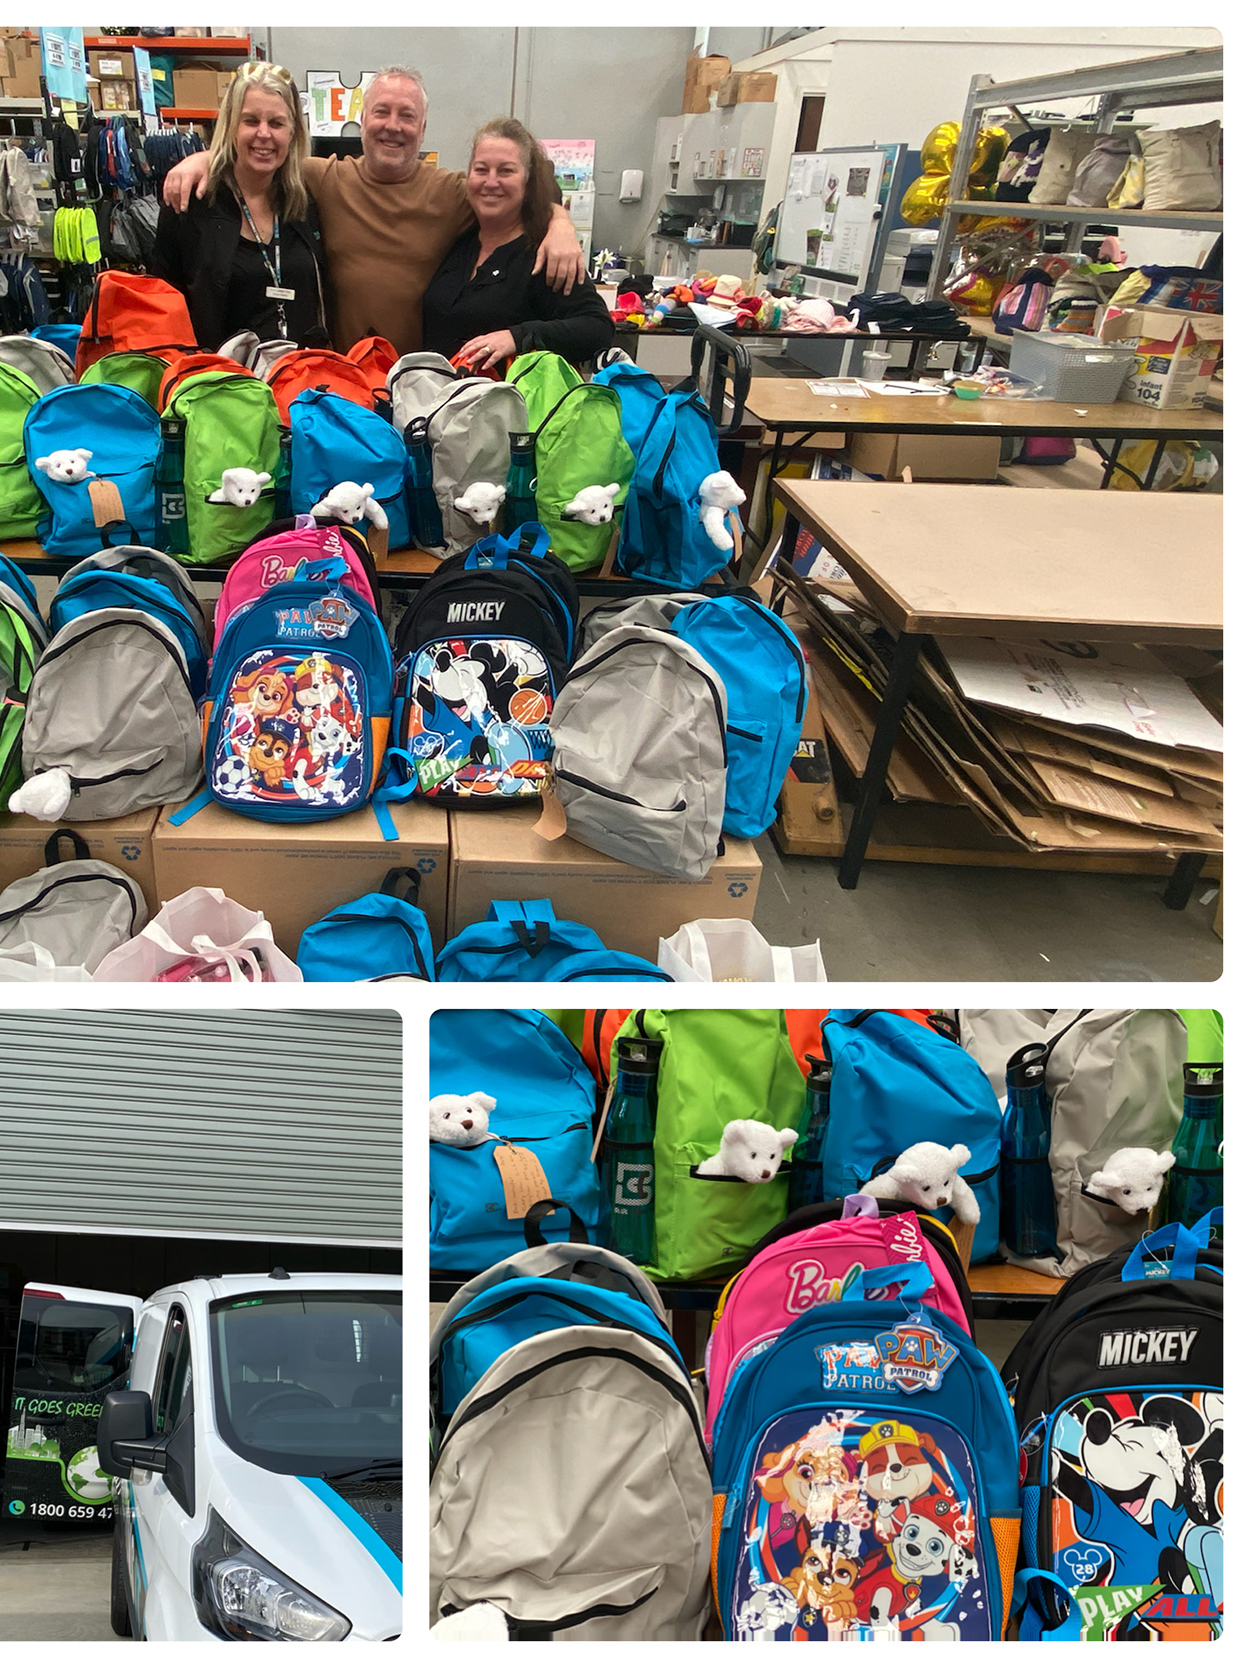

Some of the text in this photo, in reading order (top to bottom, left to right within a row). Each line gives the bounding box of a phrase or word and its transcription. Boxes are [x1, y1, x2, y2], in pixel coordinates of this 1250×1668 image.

[1137, 388, 1160, 402] 104
[261, 555, 323, 589] Bare
[309, 602, 358, 626] PAW
[447, 602, 505, 623] MICKEY
[317, 624, 344, 633] PATROL
[793, 741, 816, 758] AT
[420, 760, 460, 786] PLAY
[1145, 1268, 1171, 1276] MICKEY
[786, 1259, 889, 1315] Bare
[875, 1333, 957, 1370] PAW
[1099, 1331, 1198, 1367] MICKEY
[890, 1367, 932, 1382] PATROL
[14, 1398, 26, 1410] IT
[28, 1400, 63, 1414] GOES
[29, 1503, 64, 1517] 1800
[68, 1505, 94, 1518] 659
[1076, 1564, 1094, 1575] 28
[1077, 1586, 1143, 1628] PLAY
[1146, 1597, 1218, 1617] ALL
